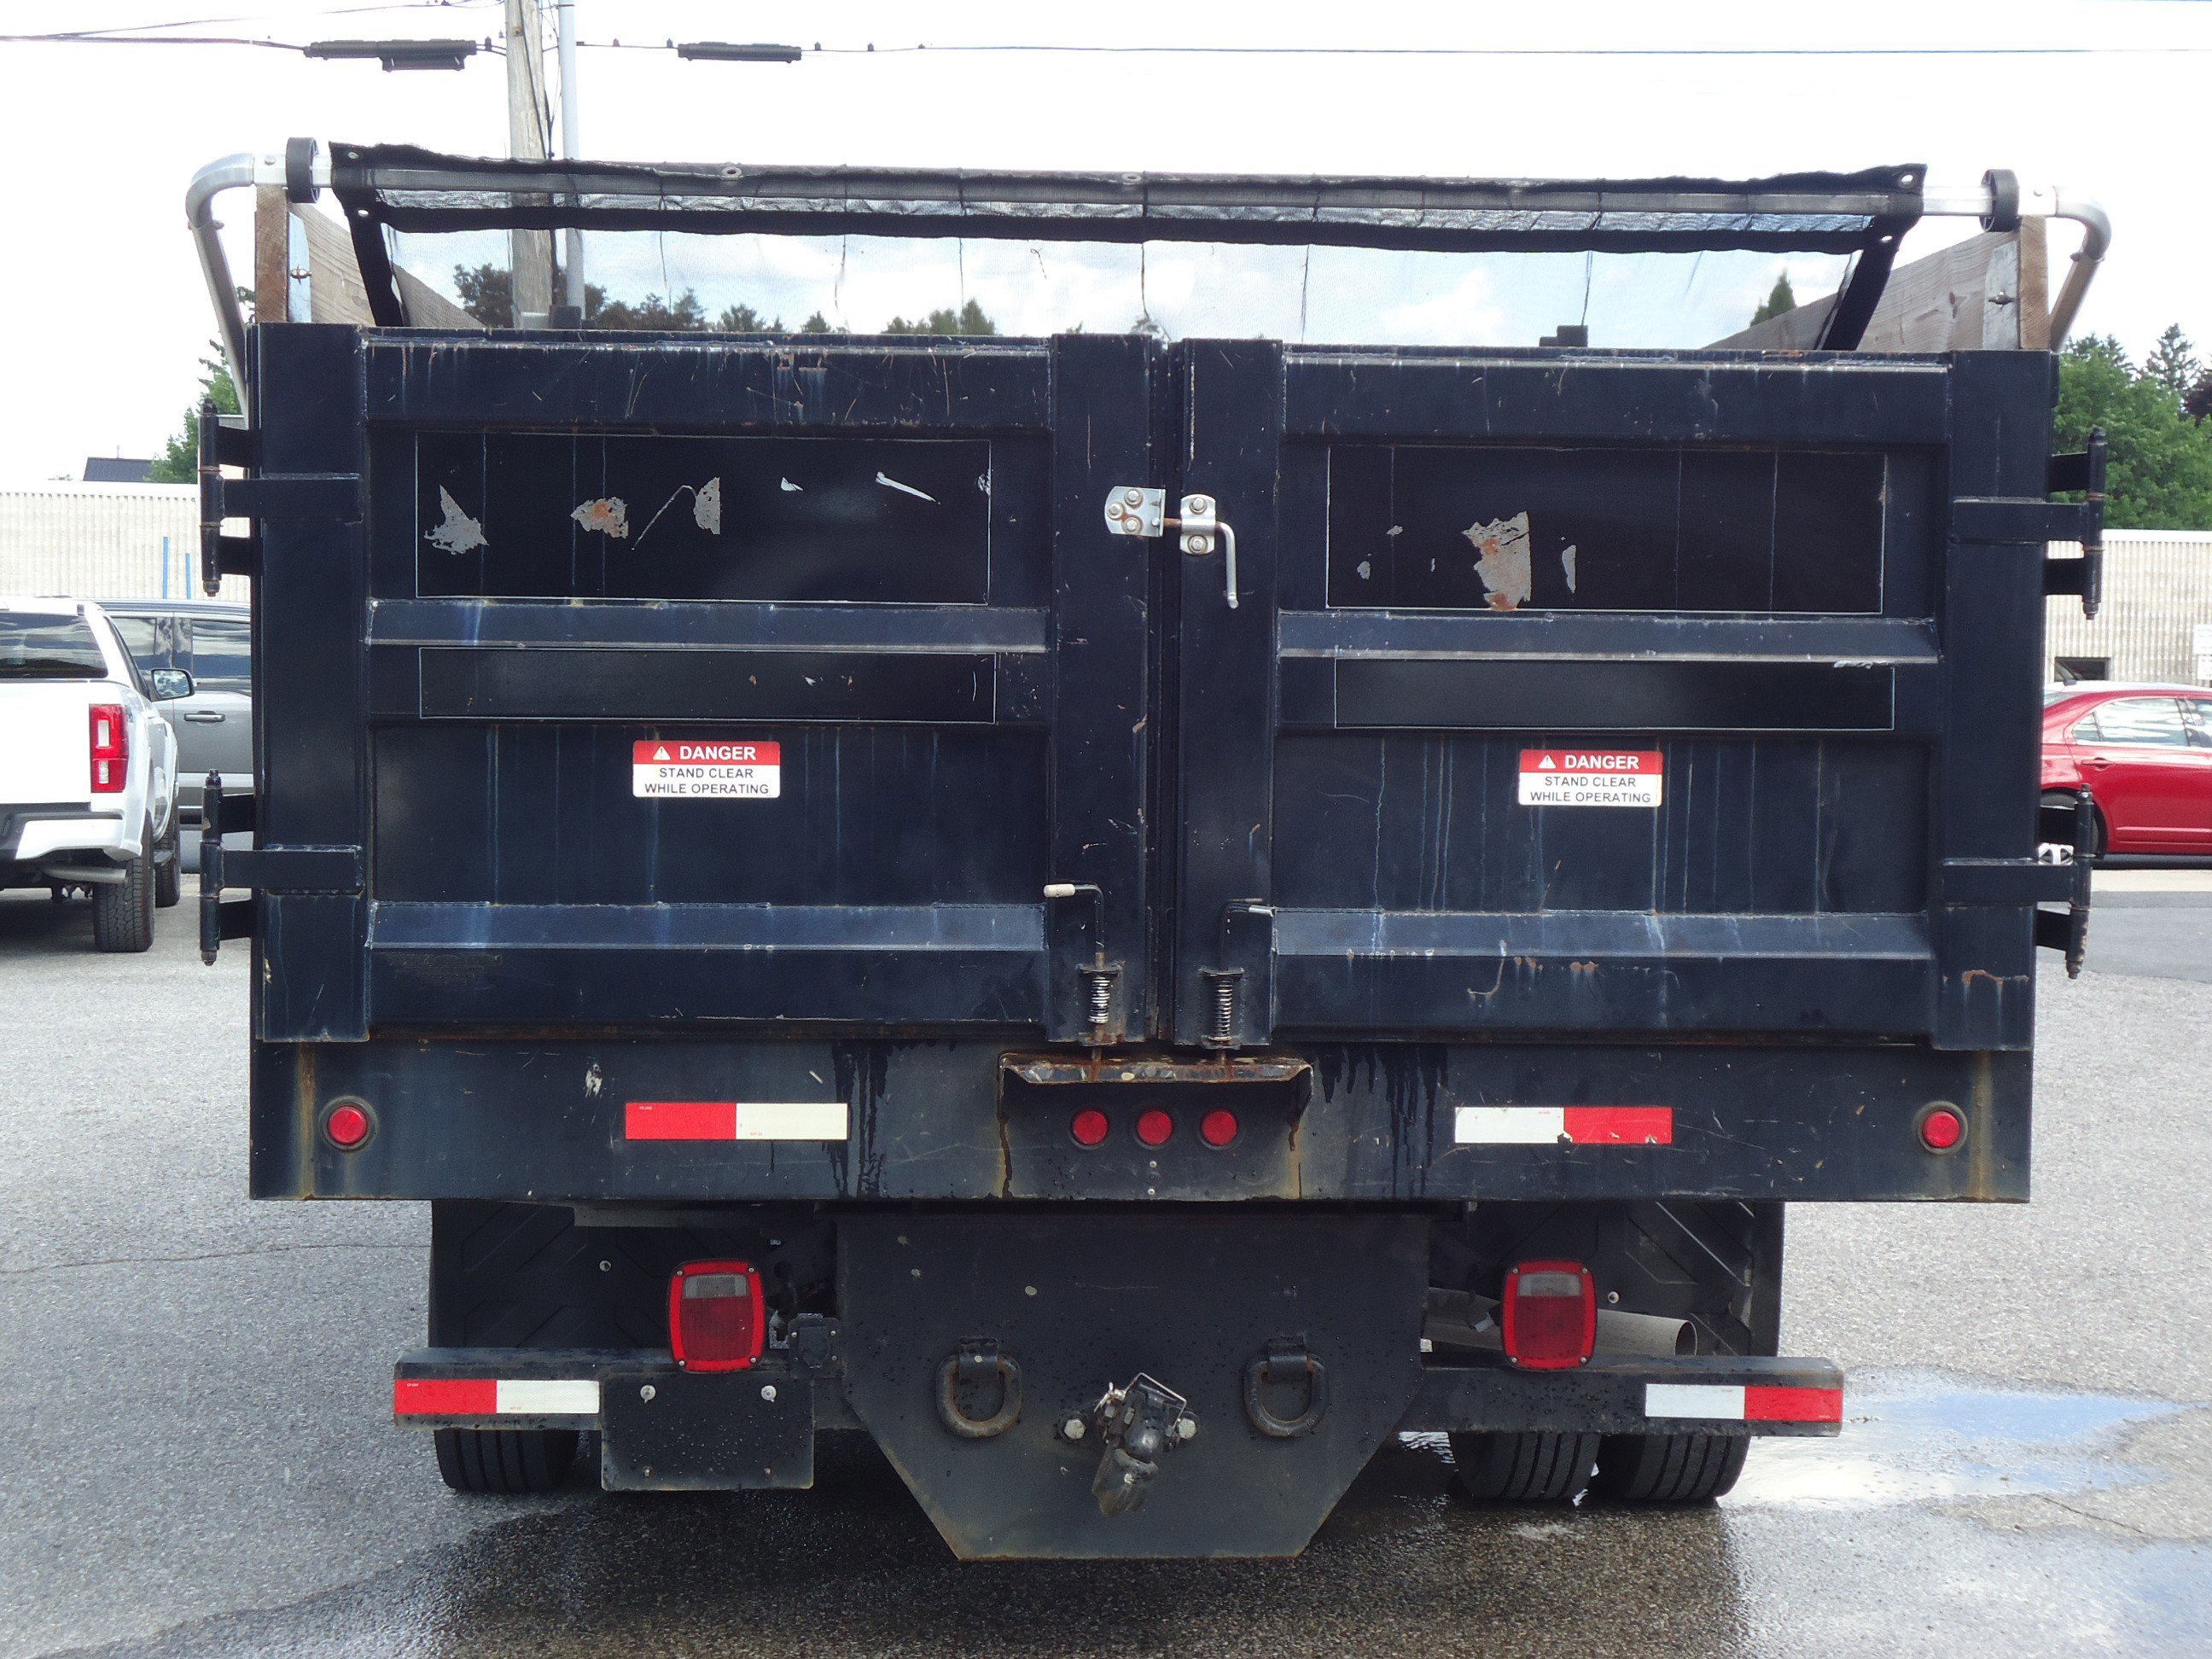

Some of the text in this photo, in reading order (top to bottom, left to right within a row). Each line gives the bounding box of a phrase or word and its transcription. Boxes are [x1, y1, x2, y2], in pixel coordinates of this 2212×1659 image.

[679, 746, 756, 761] DANGER
[1564, 754, 1640, 770] DANGER
[660, 768, 754, 778] STAND CLEAR
[1545, 776, 1636, 787] STAND CLEAR
[644, 783, 769, 795] WHILE OPERATING
[1530, 792, 1651, 803] WHILE OPERATING
